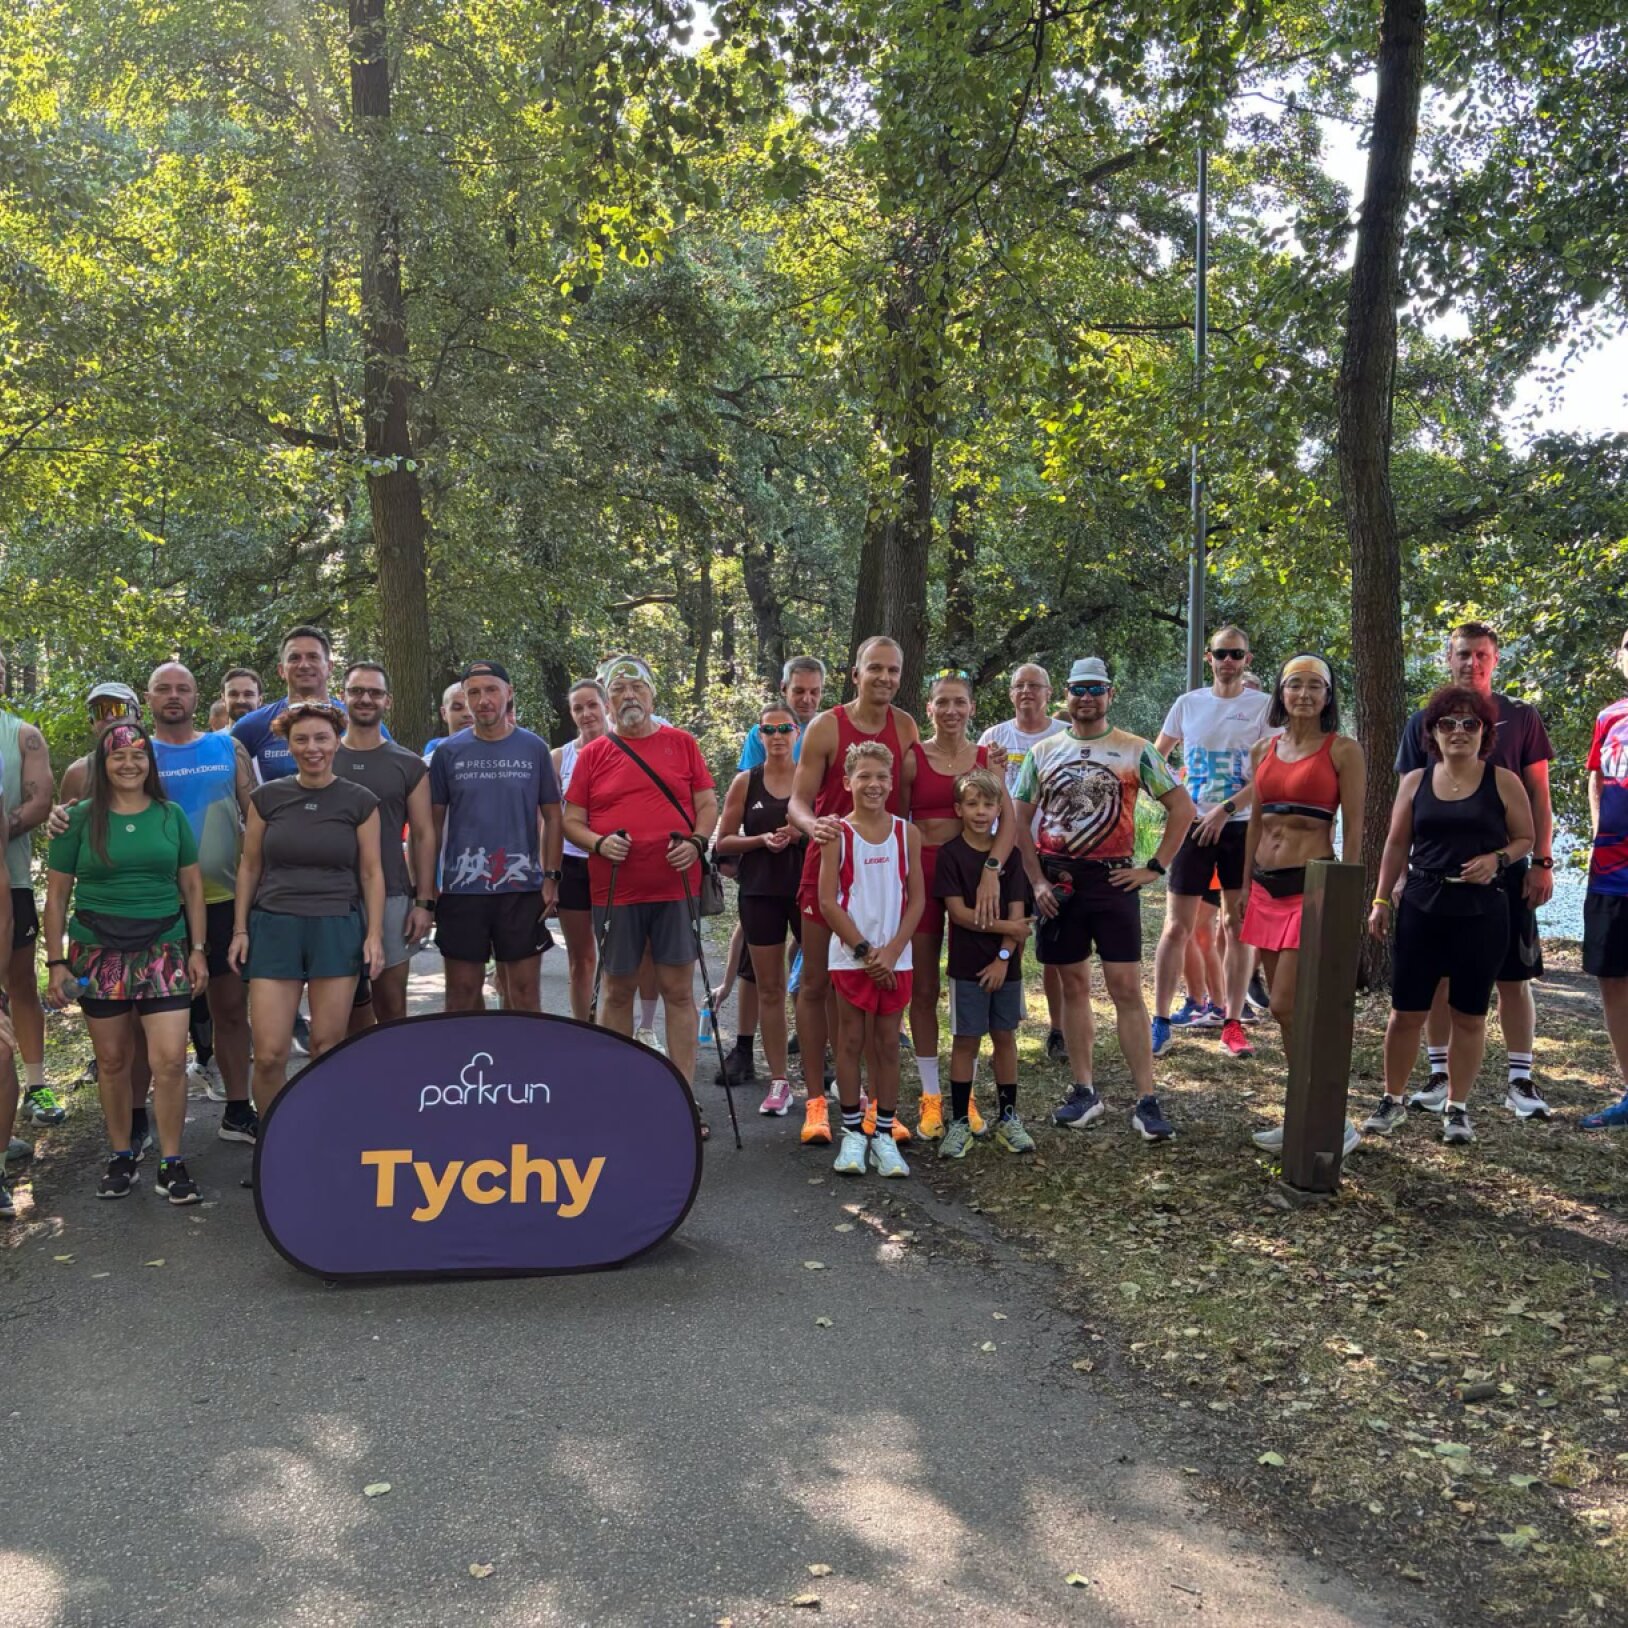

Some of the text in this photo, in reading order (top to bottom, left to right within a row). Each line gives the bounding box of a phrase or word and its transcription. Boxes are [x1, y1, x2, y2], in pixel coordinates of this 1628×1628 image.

[455, 770, 531, 780] SPORT AND SUPPORT
[466, 759, 533, 769] PRESSGLASS
[418, 1053, 550, 1112] parkrun
[360, 1143, 606, 1222] Tychy
